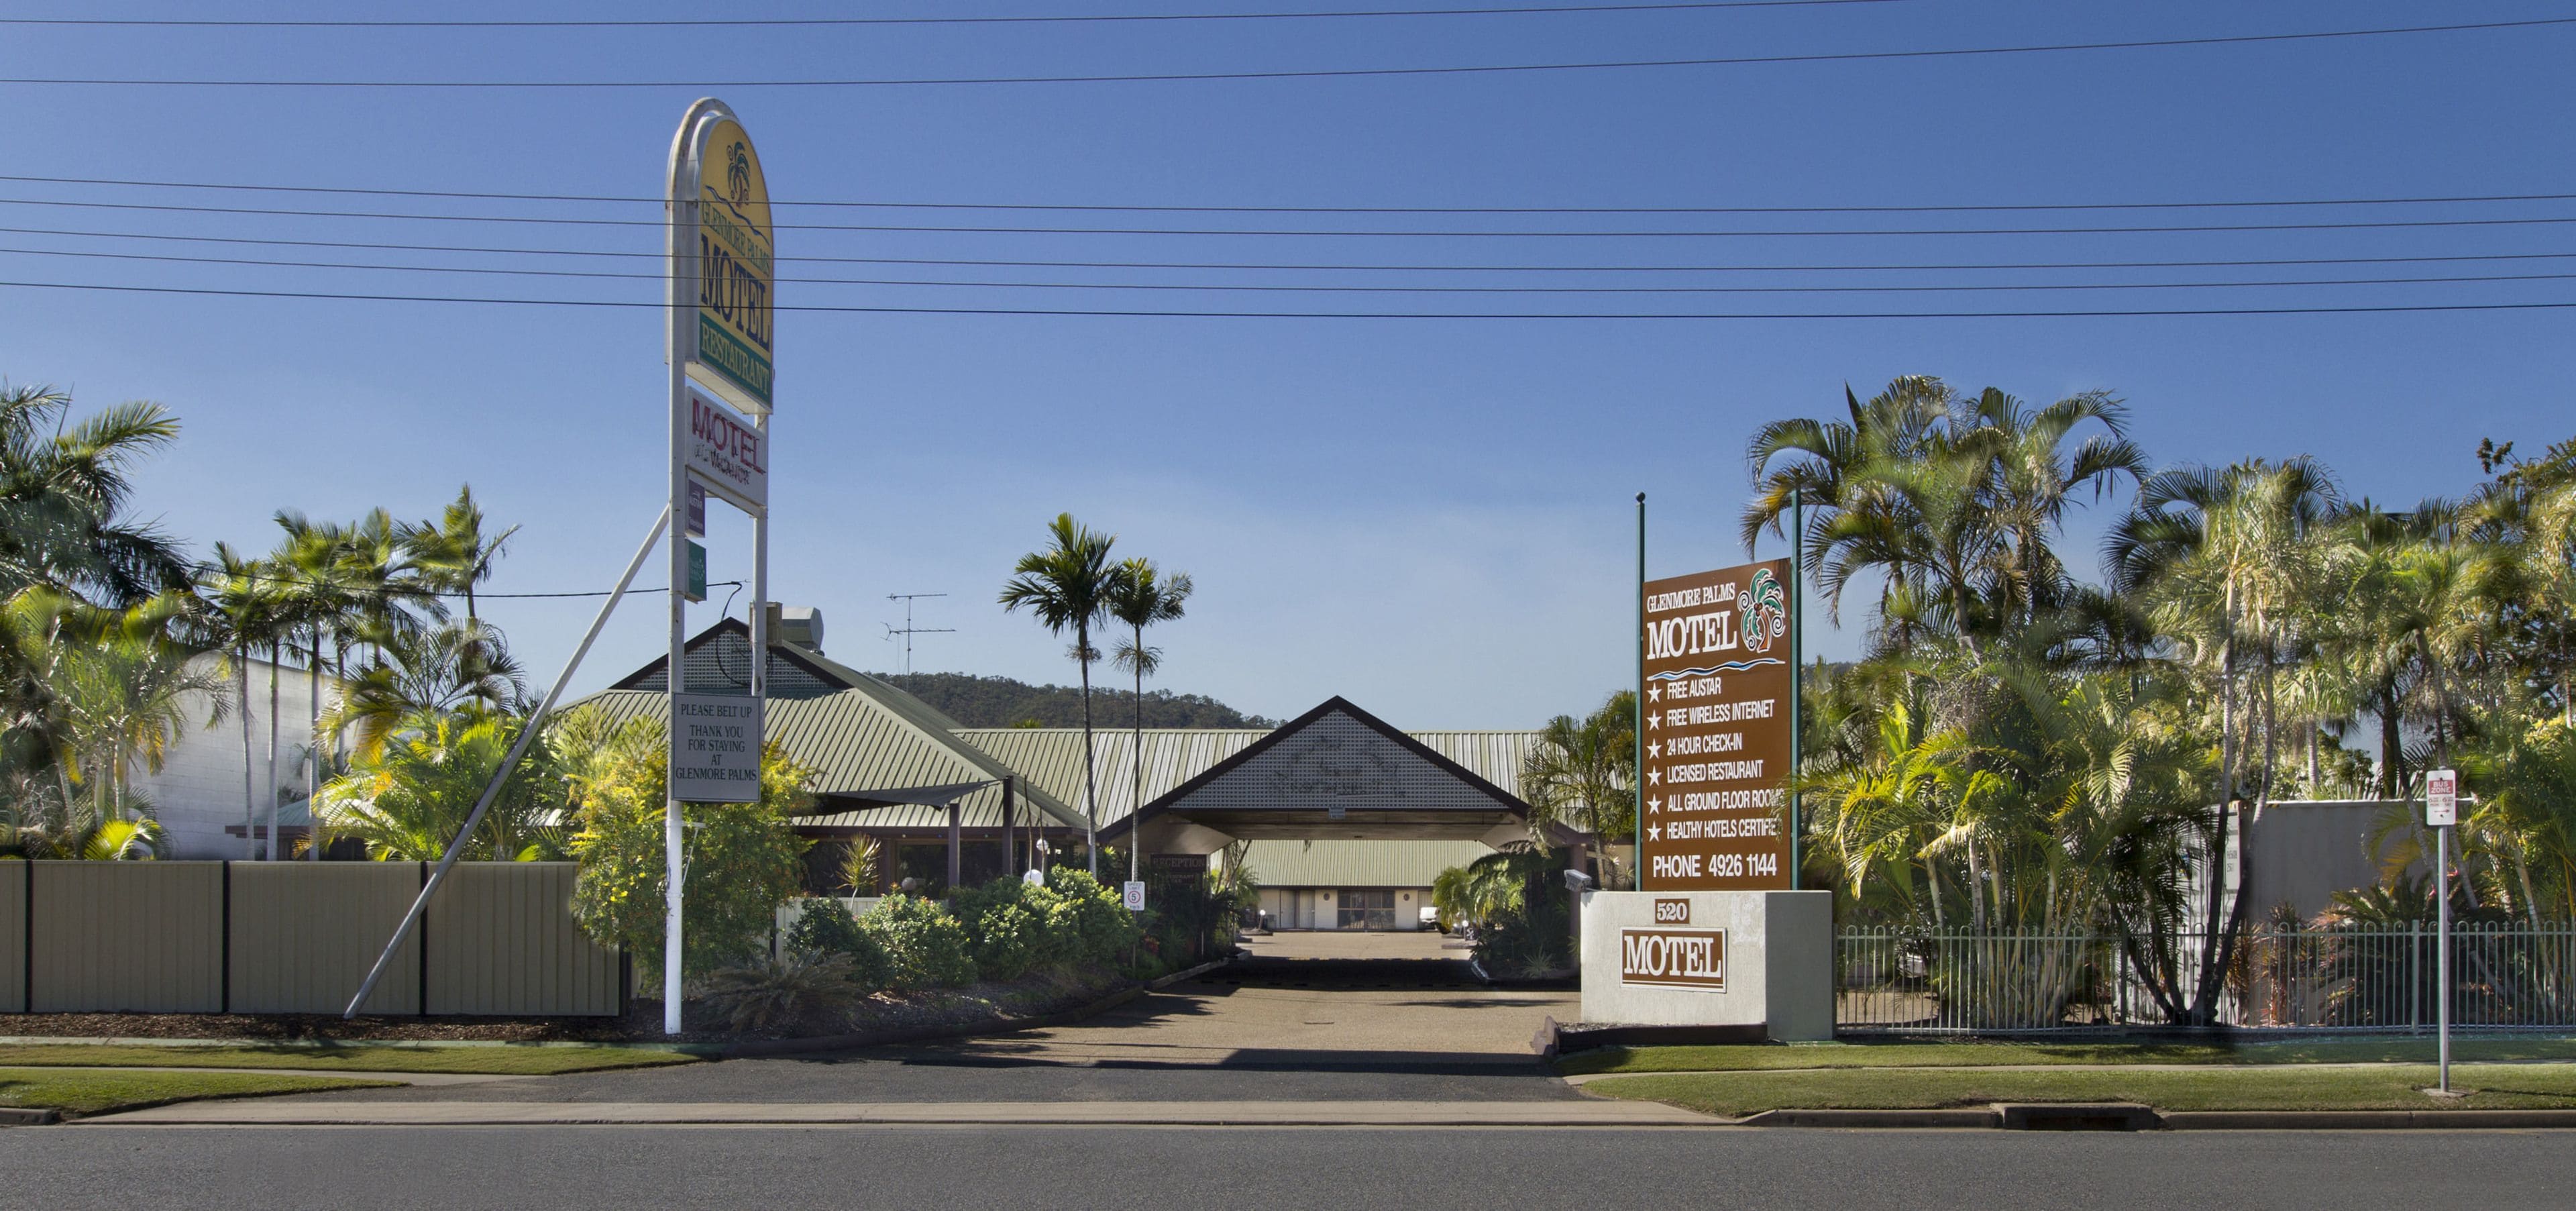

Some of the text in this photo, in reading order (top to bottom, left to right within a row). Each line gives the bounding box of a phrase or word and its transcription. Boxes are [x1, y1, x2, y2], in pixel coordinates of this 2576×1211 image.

[702, 199, 770, 278] GLENMORE PALMS
[701, 233, 770, 352] MOTEL
[702, 321, 769, 394] RESTAURANT
[692, 398, 766, 474] MOTEL
[1647, 582, 1735, 613] GLENMORE PALMS
[1647, 611, 1737, 660] MOTEL
[1667, 677, 1721, 700] FREE AUSTAR
[681, 704, 752, 718] PLEASE BELT UP
[1667, 699, 1774, 727] FREE WIRELESS INTERNET
[690, 725, 743, 738] THANK YOU
[688, 739, 745, 752] FOR STAYING
[1667, 733, 1742, 756] 24 HOUR CHECK-IN
[711, 755, 721, 766] AT
[1667, 760, 1763, 784] LICENSED RESTAURANT
[676, 768, 757, 780] GLENMORE PALMS
[1668, 794, 1682, 812] ALL
[1684, 792, 1721, 810] GROUND
[1722, 790, 1750, 808] FLOOR
[1667, 819, 1782, 839] HEALTHY HOTELS CERTIFIE
[1653, 853, 1777, 878] PHONE 4926 1144
[1656, 902, 1687, 921] 520
[1623, 935, 1721, 978] MOTEL
